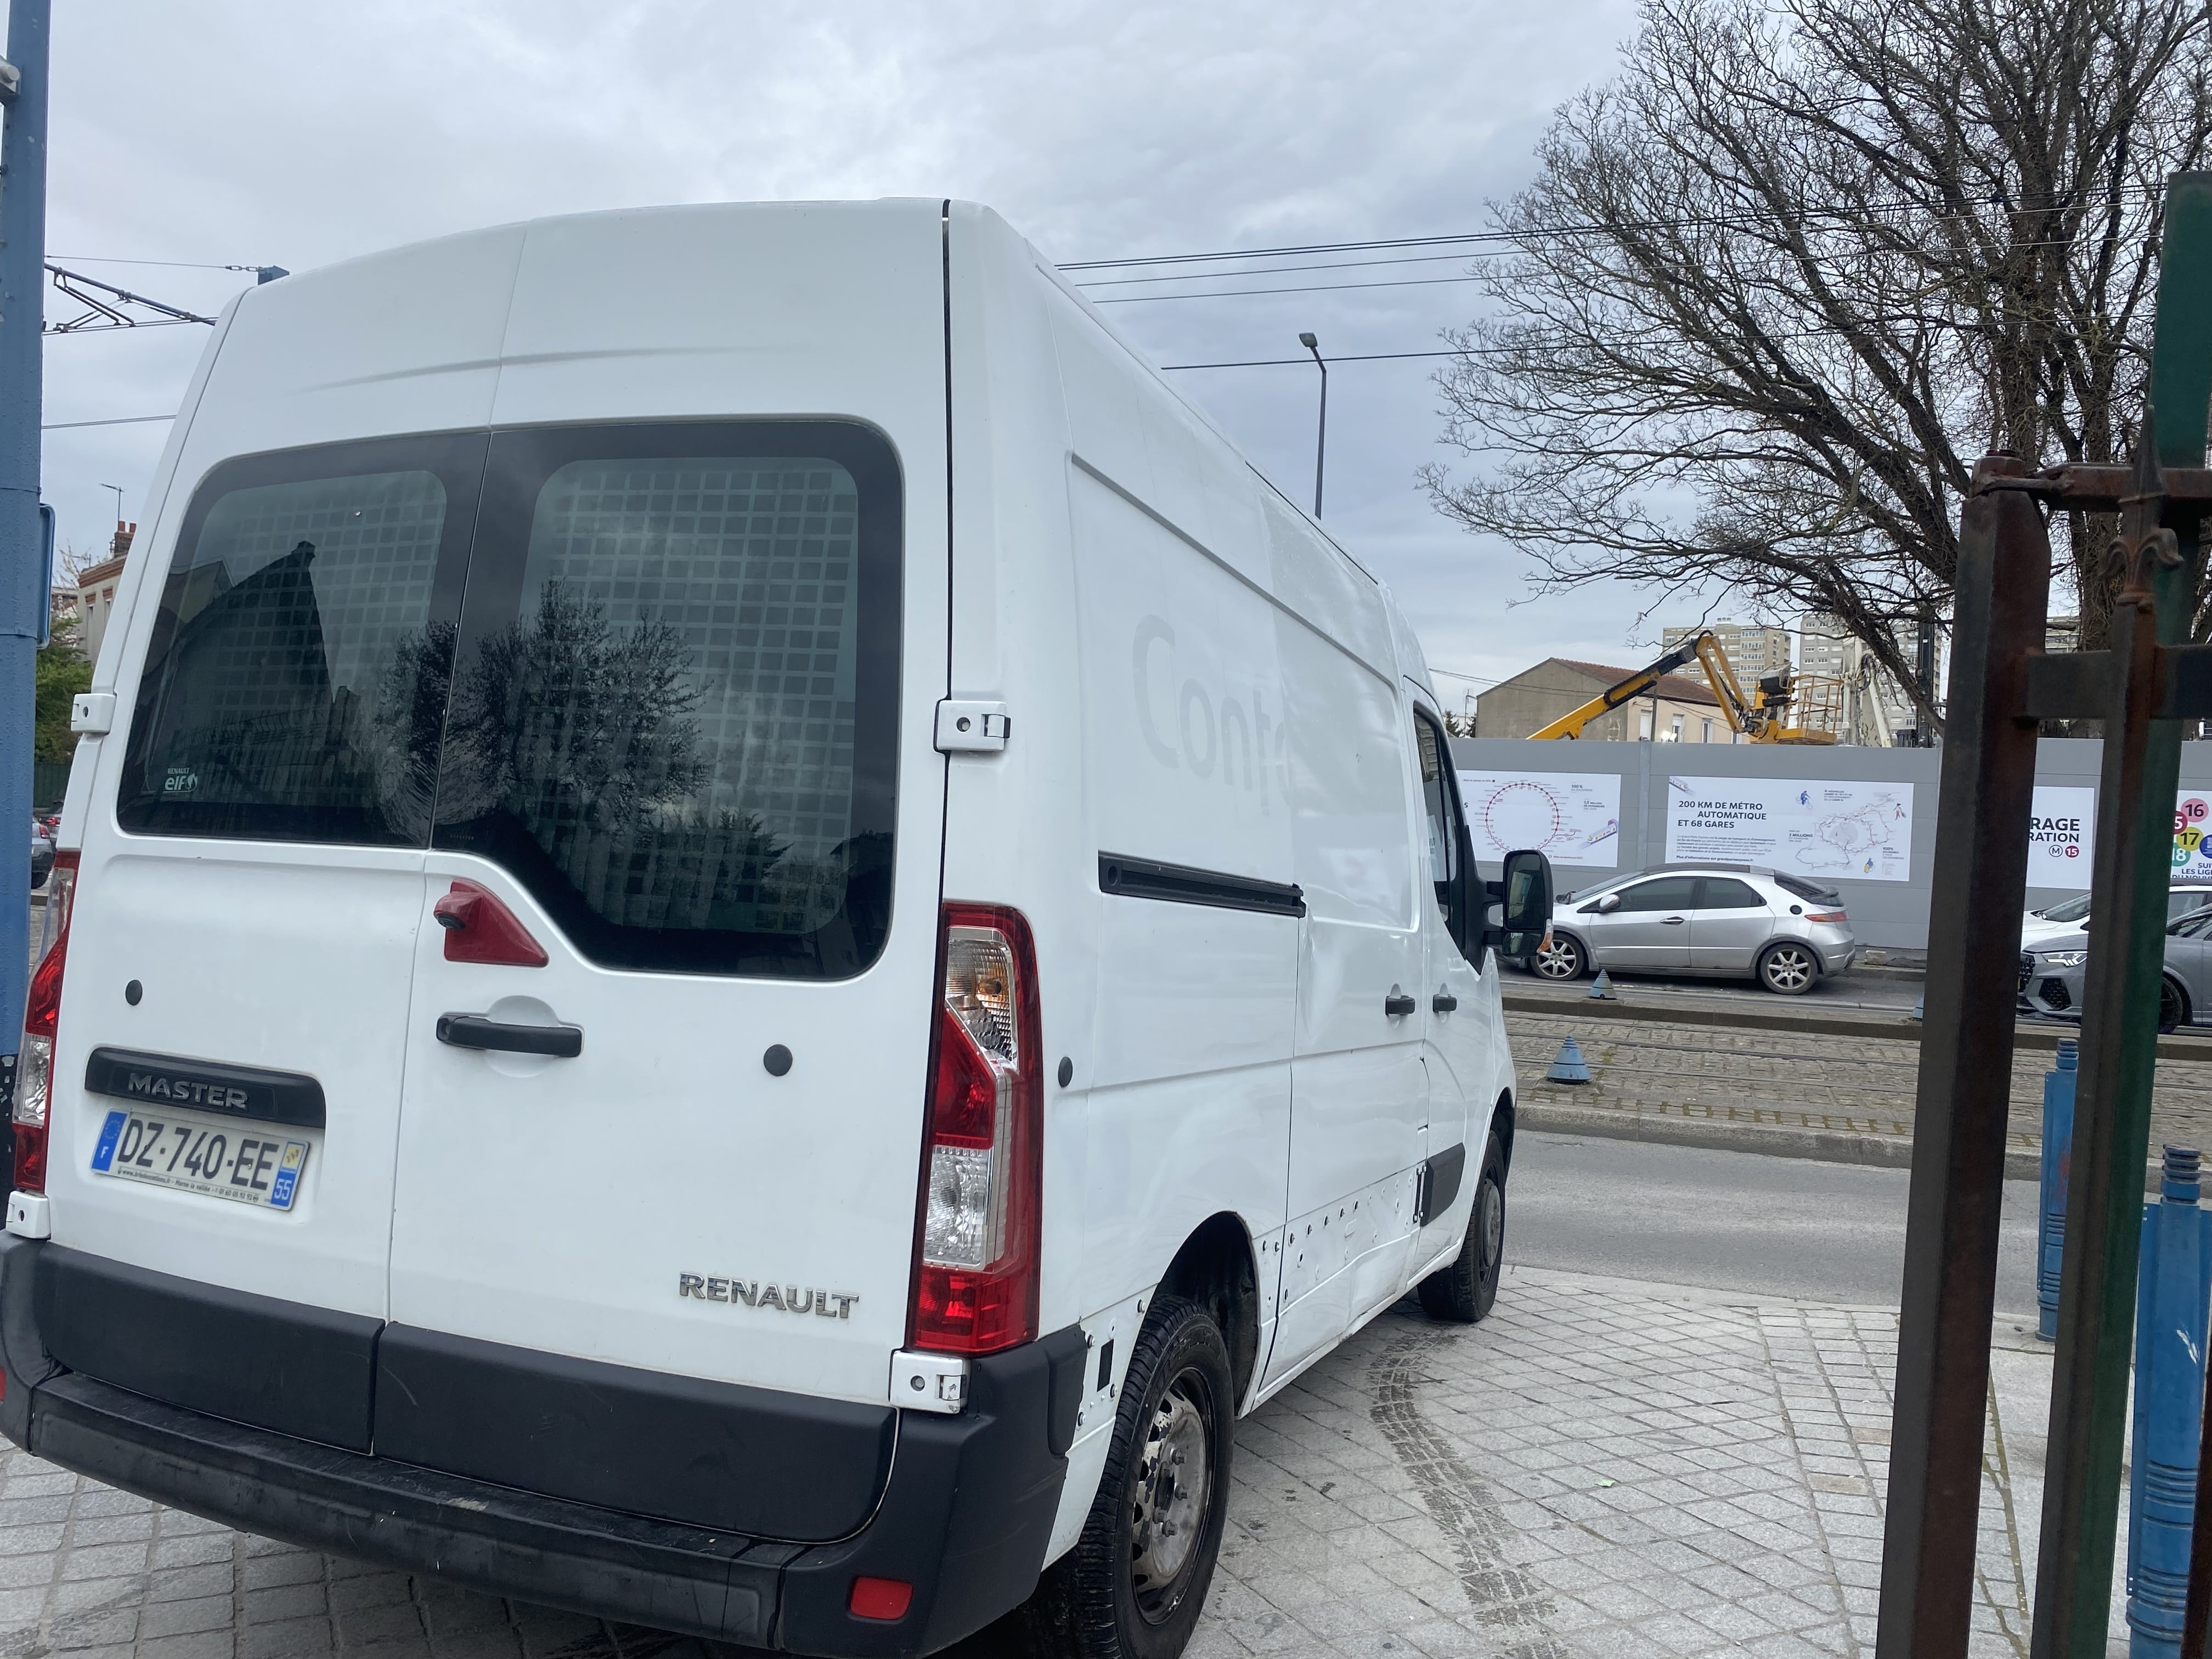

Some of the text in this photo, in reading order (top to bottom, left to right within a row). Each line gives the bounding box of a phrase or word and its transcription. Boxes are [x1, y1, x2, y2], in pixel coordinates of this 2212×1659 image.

[165, 776, 187, 791] elf
[1729, 802, 1763, 810] MÉTRO
[2185, 804, 2204, 817] 16
[1697, 811, 1767, 820] AUTOMATIQUE
[2030, 817, 2080, 831] RAGE
[2174, 816, 2183, 830] 5
[2029, 832, 2080, 843] RATION
[2180, 832, 2199, 845] 17
[2067, 848, 2078, 856] 15
[128, 1073, 249, 1110] MASTER
[100, 1146, 109, 1159] F
[274, 1178, 292, 1200] 55
[679, 1271, 860, 1319] RENAULT
